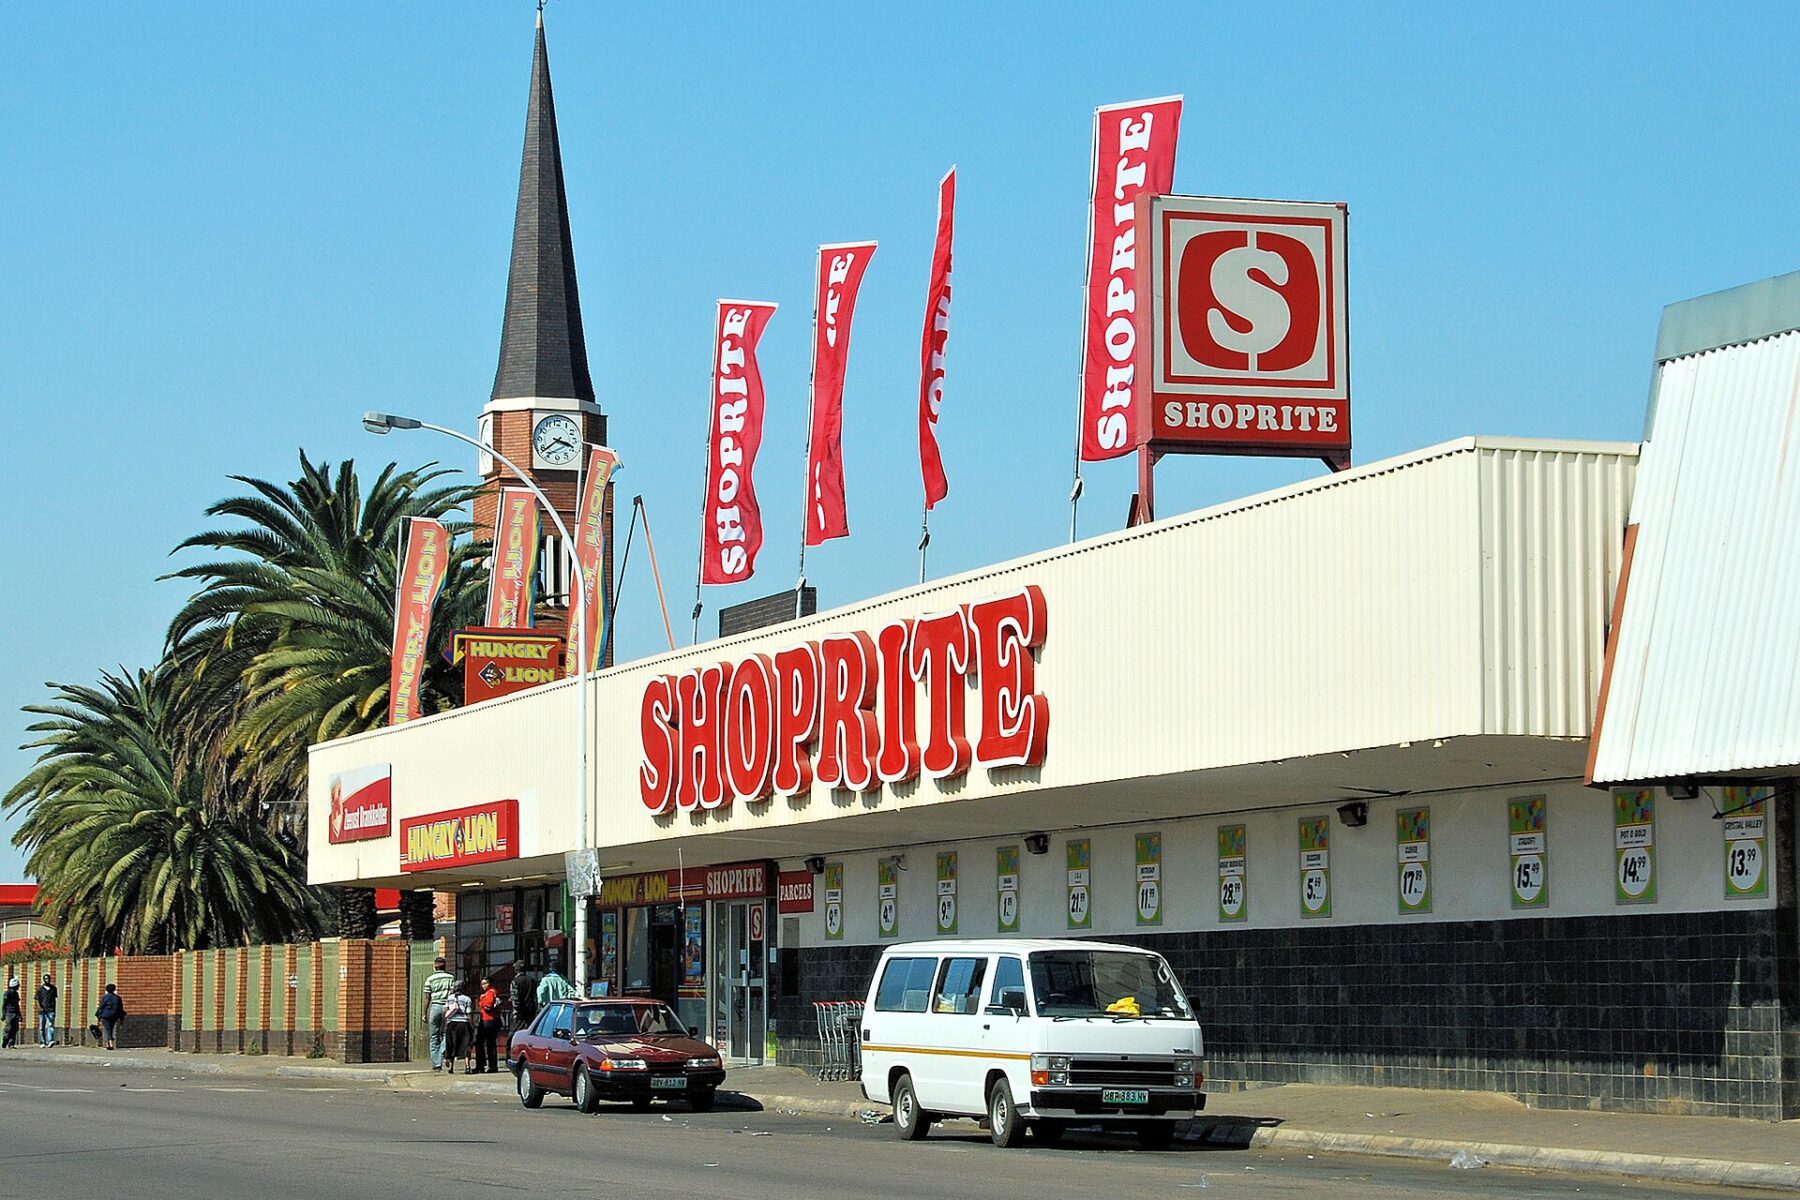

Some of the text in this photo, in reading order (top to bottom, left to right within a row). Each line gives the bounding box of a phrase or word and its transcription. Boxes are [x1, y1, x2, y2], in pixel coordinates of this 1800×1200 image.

[1097, 110, 1154, 450] SHOPRITE
[715, 307, 752, 575] SHOPRITE
[1163, 401, 1339, 433] SHOPRITE
[585, 459, 608, 546] LION
[502, 499, 527, 580] LION
[411, 529, 437, 605] LION
[470, 641, 555, 660] HUNGRY
[504, 666, 554, 683] LION
[640, 585, 1049, 816] SHOPRITE
[407, 811, 498, 864] HUNGRY LION
[644, 873, 668, 902] LION
[706, 868, 763, 896] SHOPRITE
[780, 883, 812, 901] PARCELS
